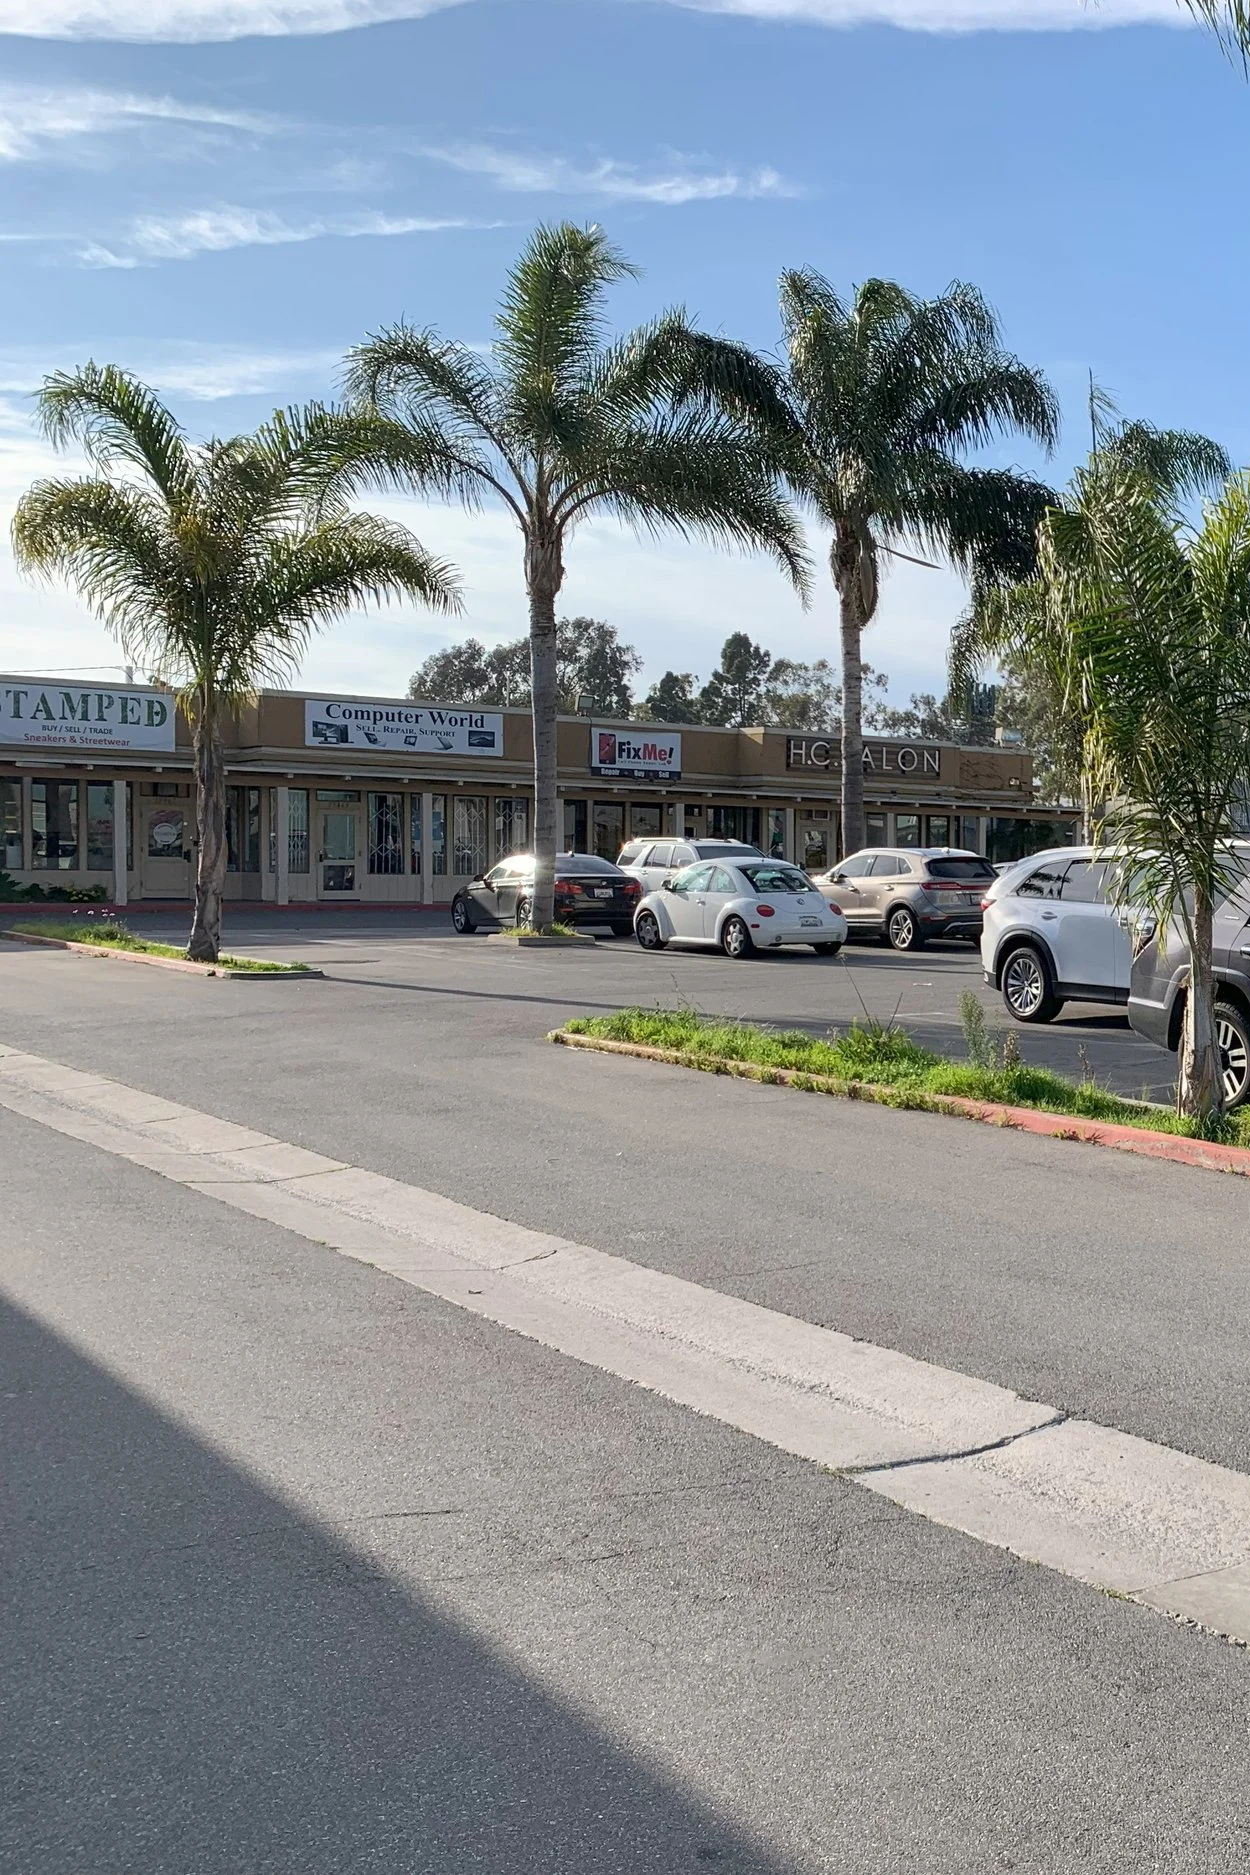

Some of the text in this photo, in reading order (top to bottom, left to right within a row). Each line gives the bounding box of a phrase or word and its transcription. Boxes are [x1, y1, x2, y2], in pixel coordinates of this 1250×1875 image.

[0, 690, 168, 728] TAMPED
[326, 703, 485, 729] Computer World
[24, 733, 130, 747] Sneakers & Streetwear
[89, 727, 113, 735] TRADE
[618, 741, 674, 764] FixMe!
[841, 745, 939, 773] ALON
[601, 768, 620, 776] Repair
[634, 770, 645, 778] Buy
